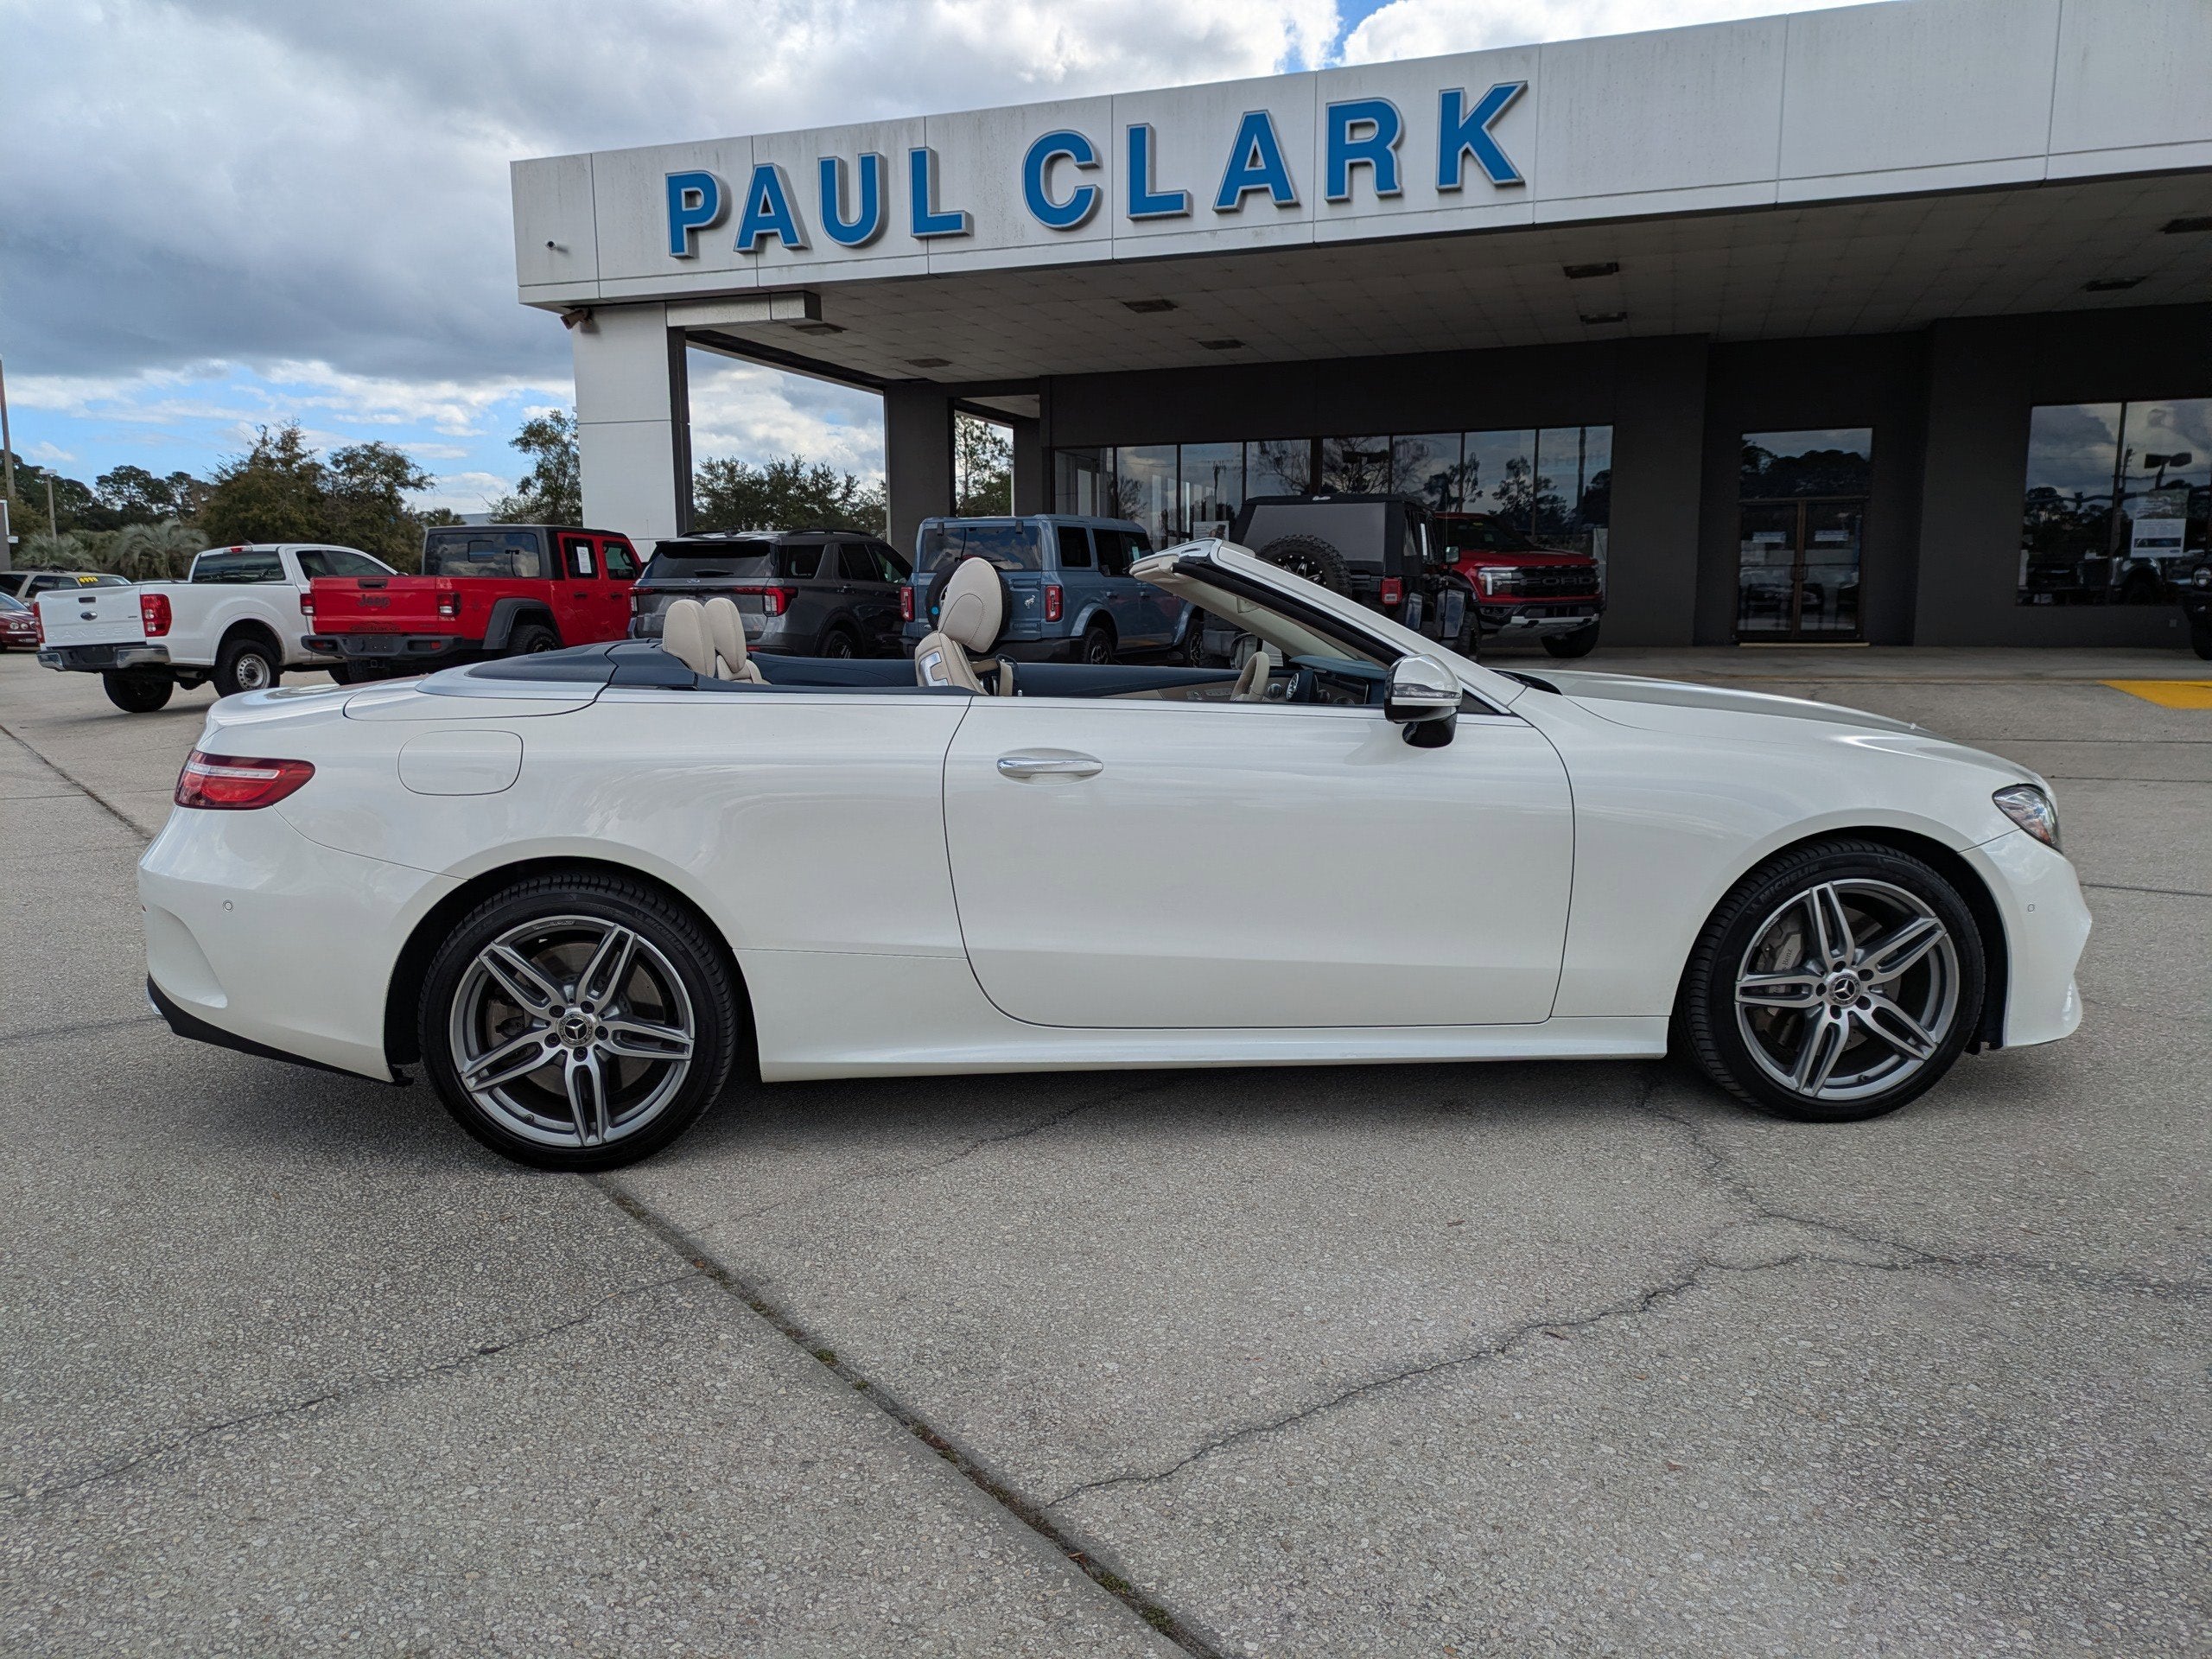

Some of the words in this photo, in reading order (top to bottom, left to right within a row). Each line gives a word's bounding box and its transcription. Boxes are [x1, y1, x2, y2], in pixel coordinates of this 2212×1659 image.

[665, 145, 976, 259] PAUL
[1021, 79, 1529, 232] CLARK
[358, 594, 391, 608] Jeep
[48, 625, 140, 639] RANGER
